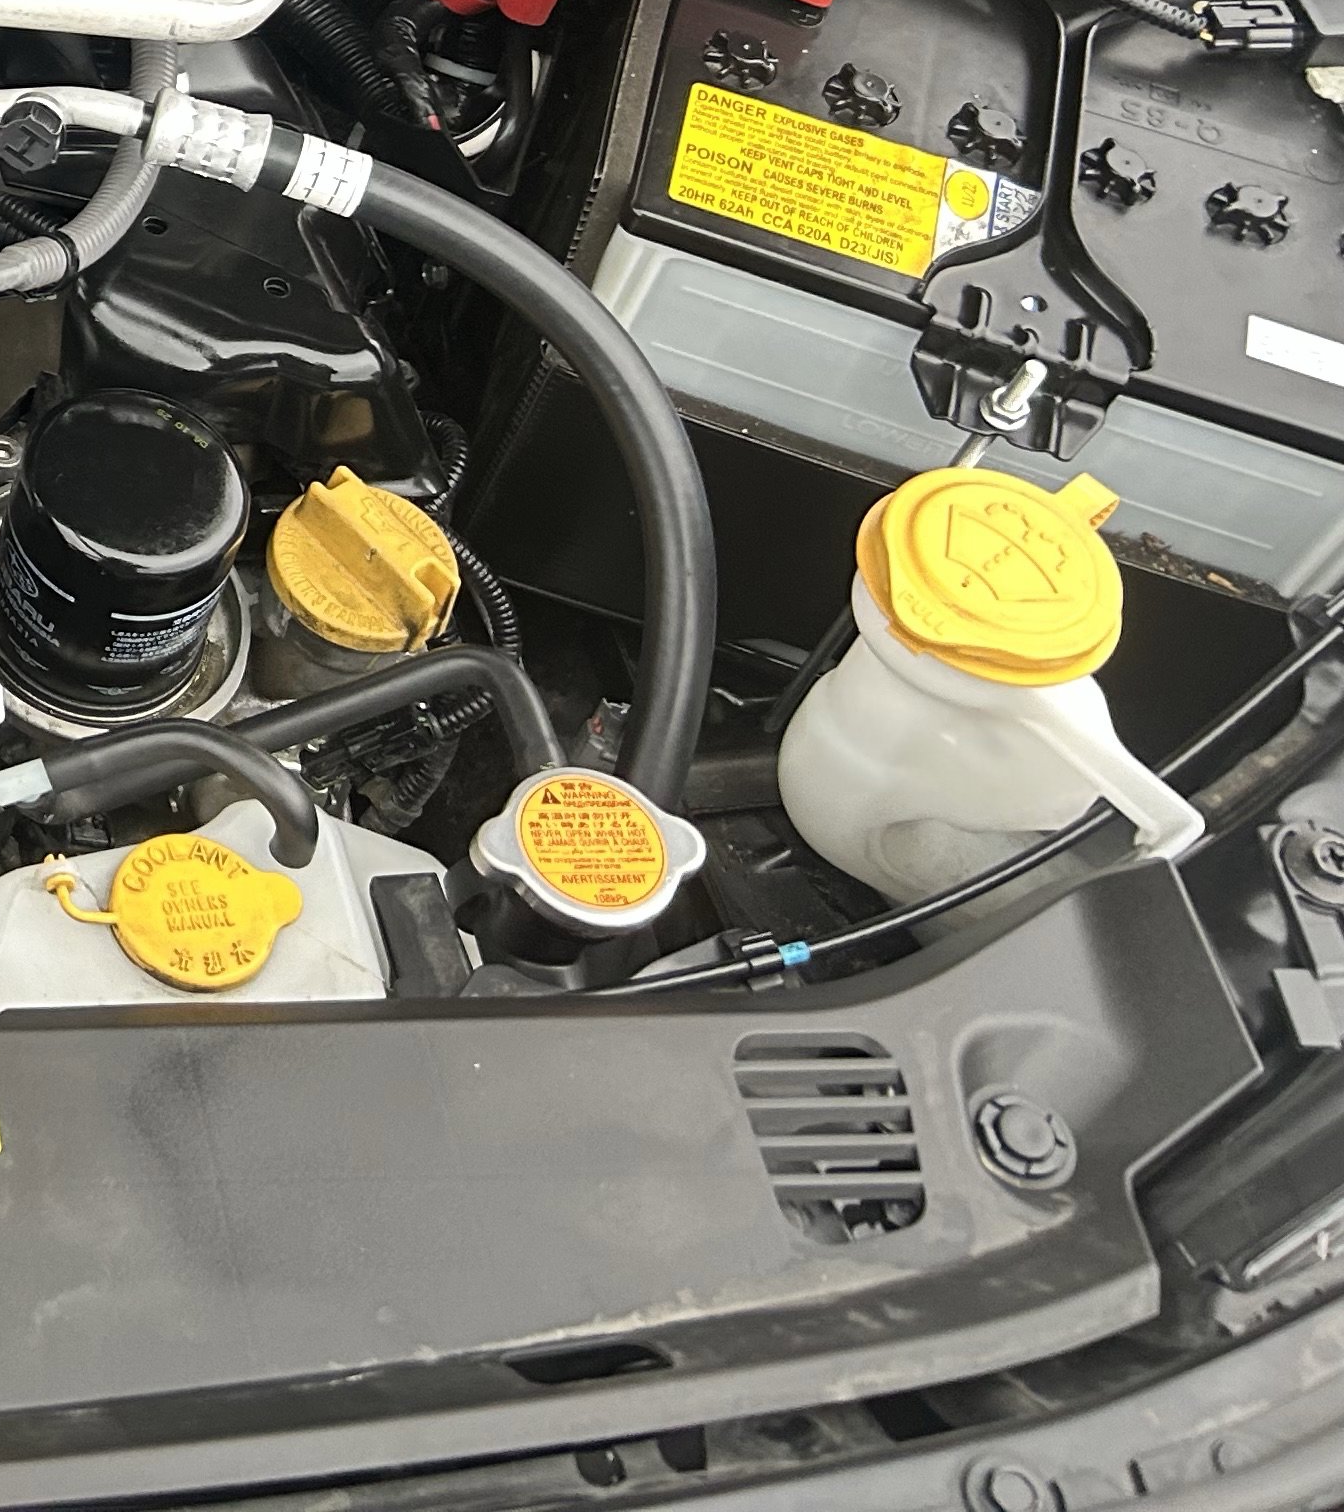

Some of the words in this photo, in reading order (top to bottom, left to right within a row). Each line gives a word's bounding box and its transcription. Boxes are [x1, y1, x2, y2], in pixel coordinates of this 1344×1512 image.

[696, 89, 768, 120] DANGER
[772, 113, 827, 137] EXPLOSIVE
[829, 130, 865, 148] GASES
[684, 143, 753, 173] POISON
[762, 169, 804, 189] CAUSES
[805, 182, 846, 202] SEVERE
[847, 196, 884, 214] BURNS
[739, 147, 767, 162] KEEP
[766, 155, 794, 171] VENT
[795, 164, 823, 180] CAPS
[824, 173, 855, 190] TIGHT
[856, 184, 879, 198] AND
[880, 192, 914, 209] LEVEL
[996, 183, 1014, 223] START
[677, 185, 716, 206] 20HR
[718, 198, 755, 218] 62Ah
[760, 212, 795, 232] CCA
[795, 223, 833, 244] 620A
[838, 237, 901, 266] D23(JIS)
[729, 188, 757, 204] KEEP
[758, 198, 780, 211] OUT
[781, 205, 796, 216] OF
[798, 210, 836, 229] REACH
[837, 222, 850, 233] OF
[851, 227, 904, 251] CHILDREN
[560, 791, 616, 800] WARNING
[530, 830, 562, 838] NEVER
[565, 830, 591, 838] OPEN
[596, 830, 624, 838] WHEN
[122, 841, 249, 893] COOLANT
[561, 874, 646, 884] AVERTISSEMENT
